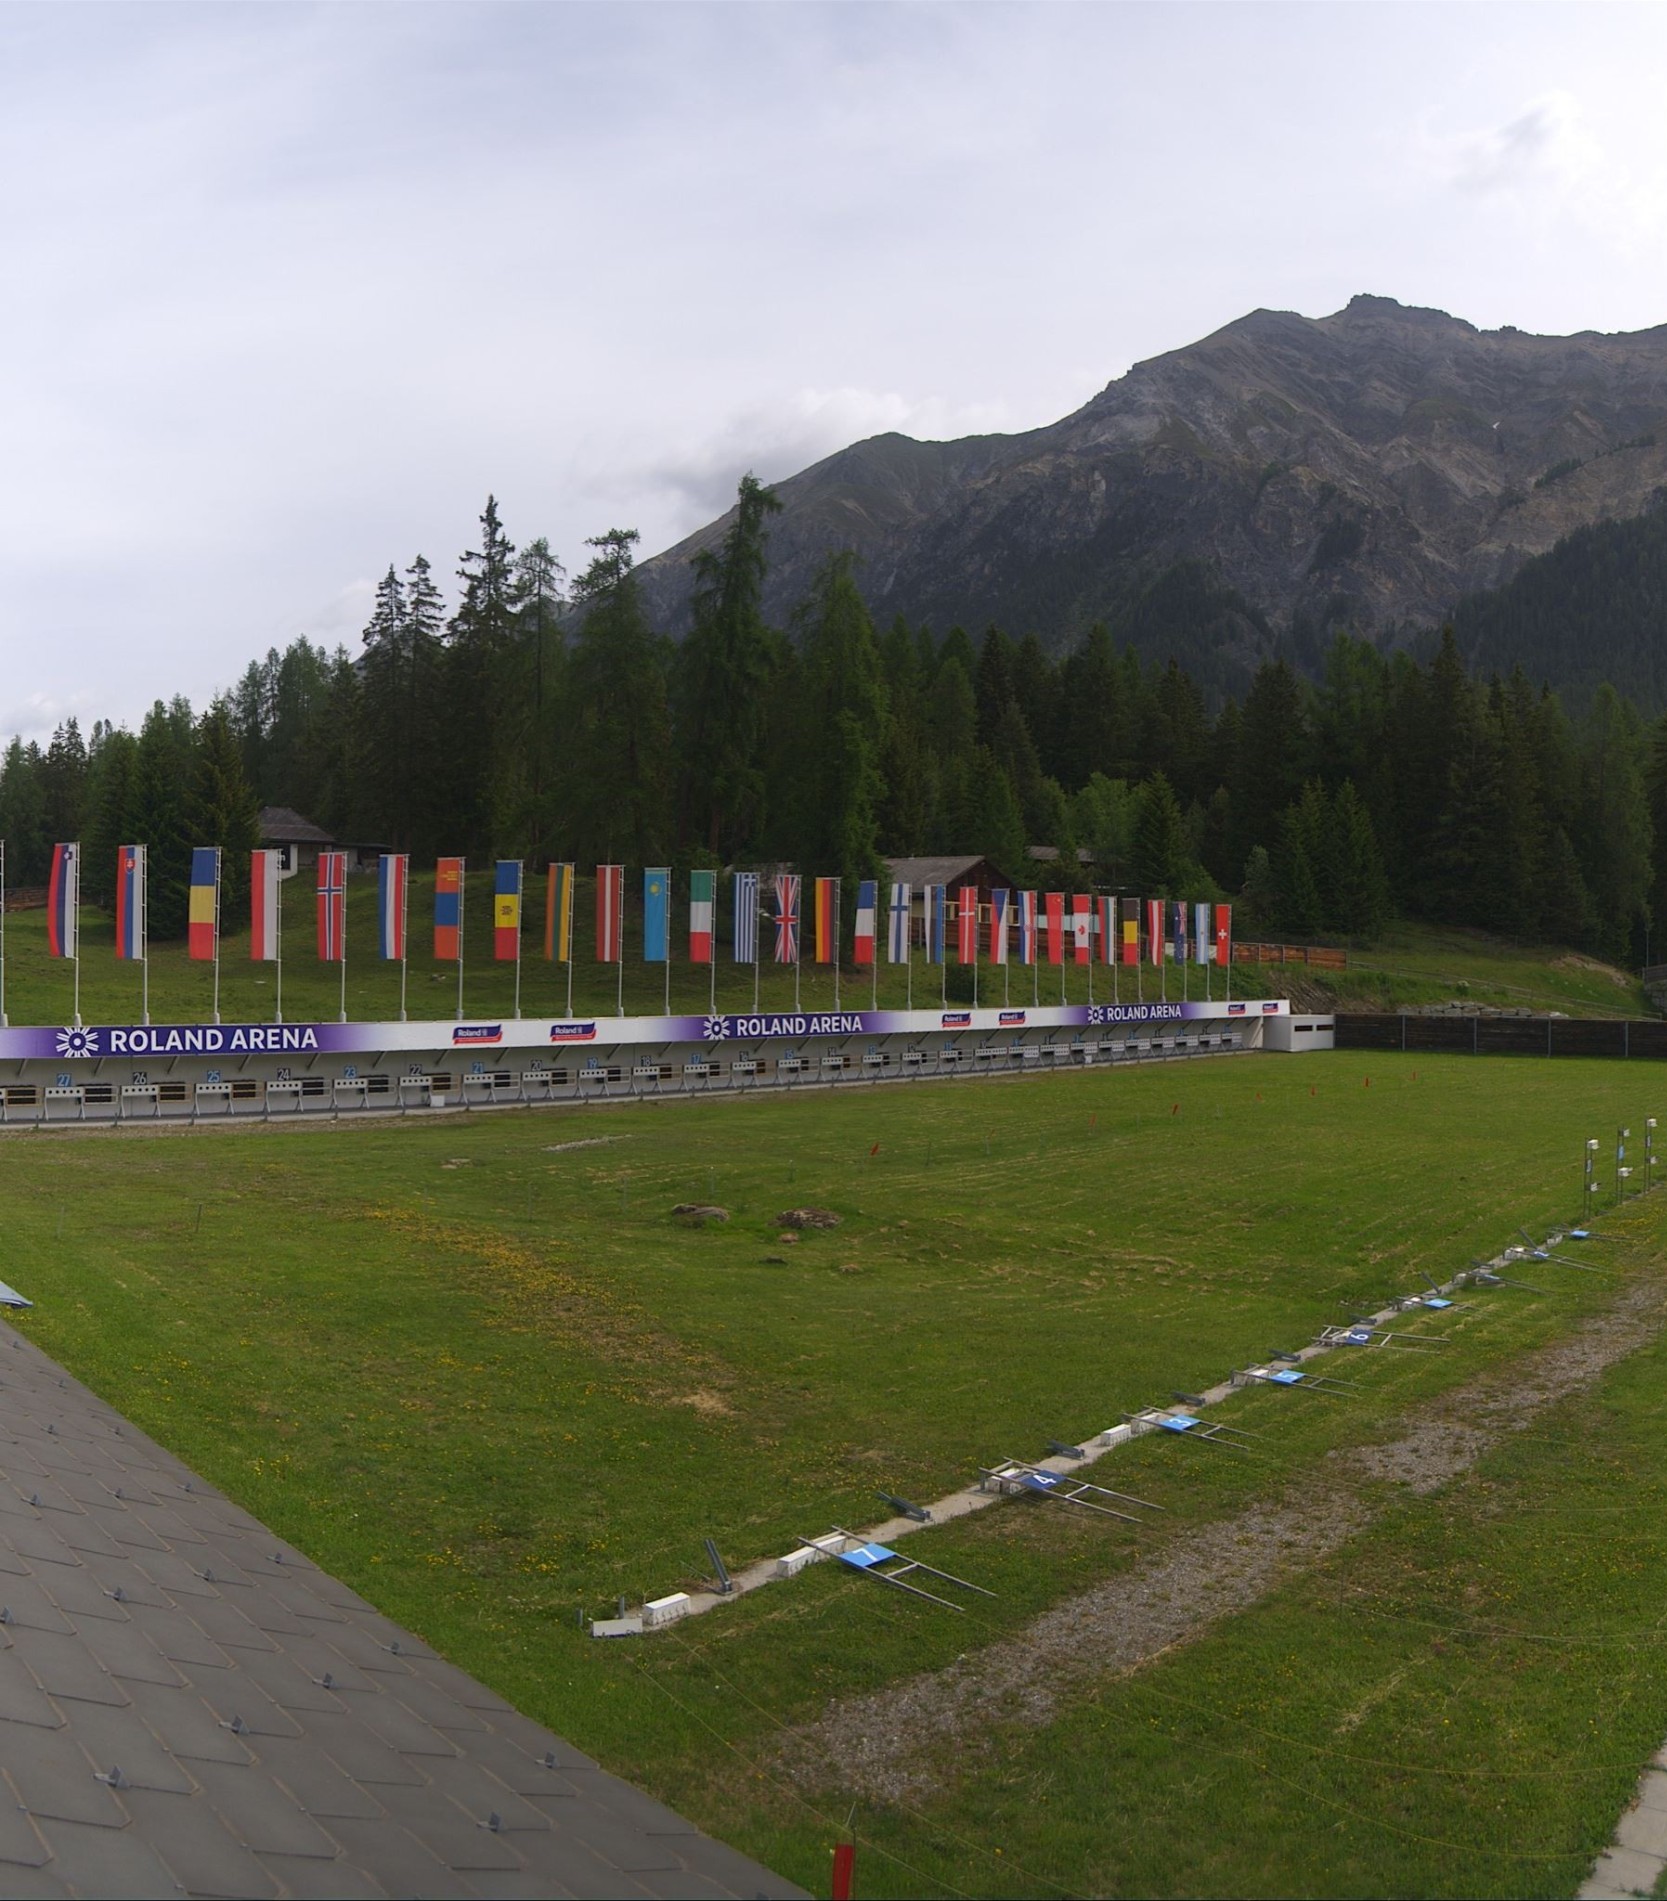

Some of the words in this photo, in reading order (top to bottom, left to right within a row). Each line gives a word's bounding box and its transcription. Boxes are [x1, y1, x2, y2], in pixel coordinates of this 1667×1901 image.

[1107, 1007, 1148, 1021] ROLAND
[1150, 1004, 1182, 1019] ARENA
[555, 1026, 577, 1034] Roland
[736, 1018, 806, 1037] ROLAND
[810, 1015, 863, 1033] ARENA
[457, 1029, 481, 1037] Roland
[110, 1029, 224, 1052] ROLAND
[230, 1028, 318, 1050] ARENA
[207, 1070, 220, 1083] 25
[277, 1068, 290, 1081] 24
[344, 1066, 357, 1078] 23
[410, 1064, 422, 1076] 22
[57, 1074, 71, 1087] 27
[133, 1072, 146, 1085] 26
[1169, 1418, 1192, 1428] 3
[1032, 1474, 1057, 1486] 4
